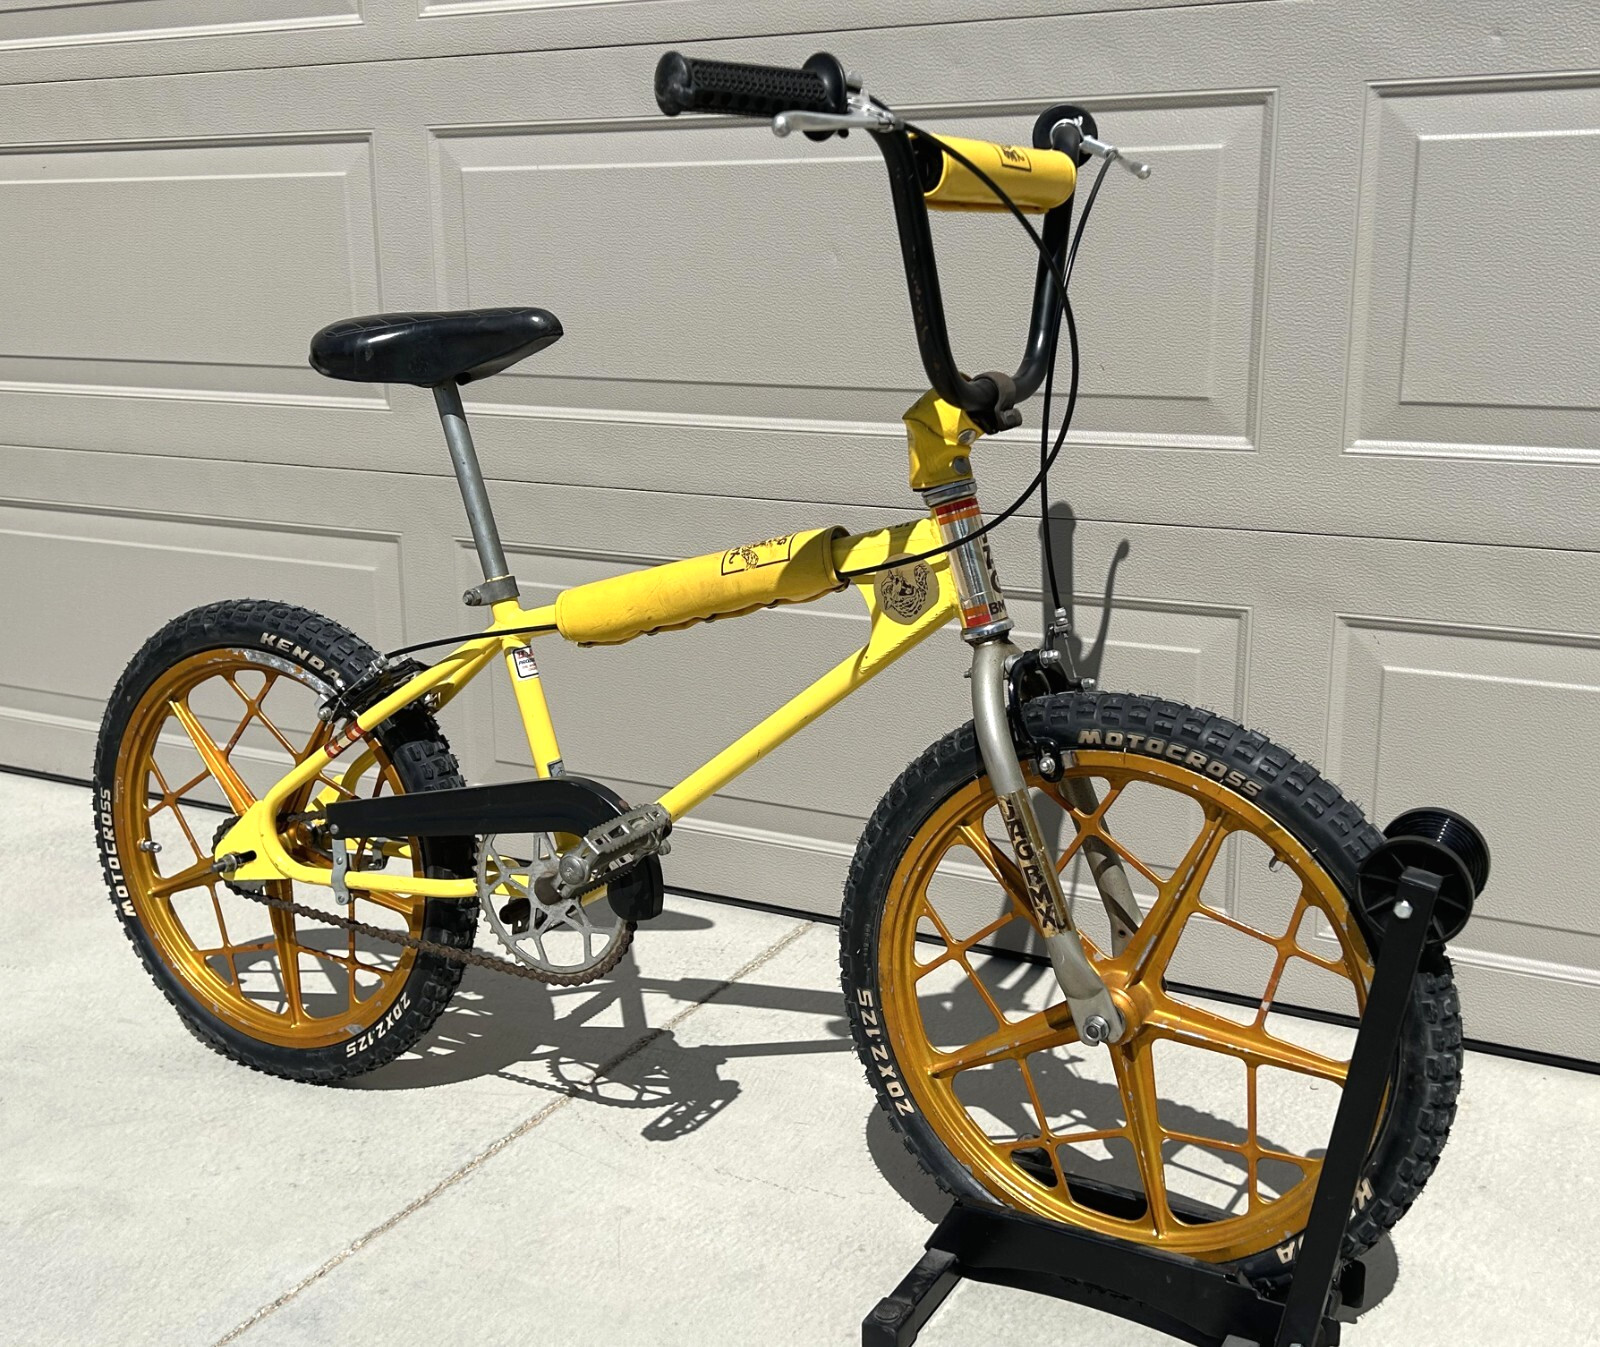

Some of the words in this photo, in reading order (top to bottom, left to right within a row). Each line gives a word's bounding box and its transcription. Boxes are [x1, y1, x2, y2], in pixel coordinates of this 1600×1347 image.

[260, 632, 341, 682] KENDA
[1077, 728, 1262, 797] MOTOCROSS
[100, 787, 137, 917] MOTOCROSS
